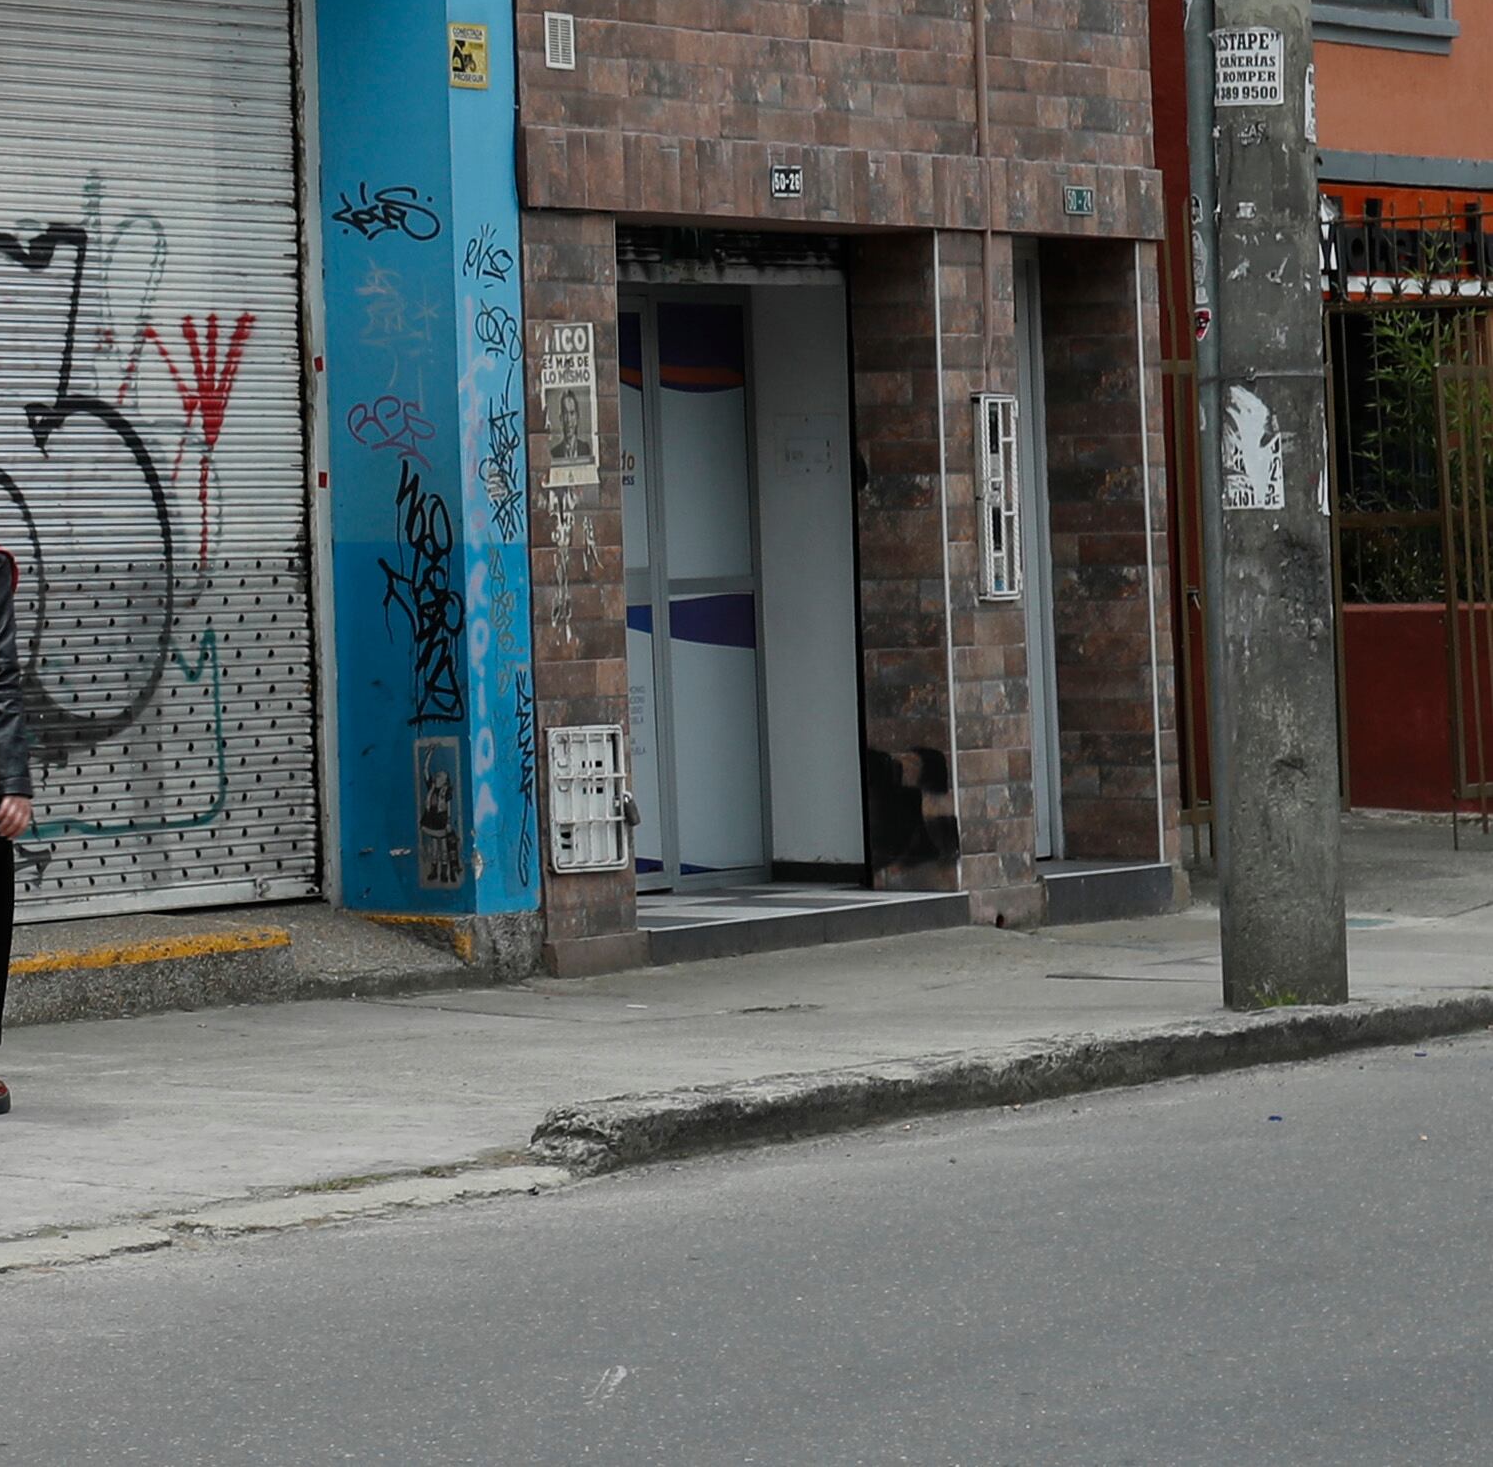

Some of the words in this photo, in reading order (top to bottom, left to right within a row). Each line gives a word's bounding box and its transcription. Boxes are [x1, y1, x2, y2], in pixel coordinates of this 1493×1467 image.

[1223, 71, 1276, 83] ROMPER
[1242, 86, 1278, 100] 9500
[544, 326, 588, 354] ICO
